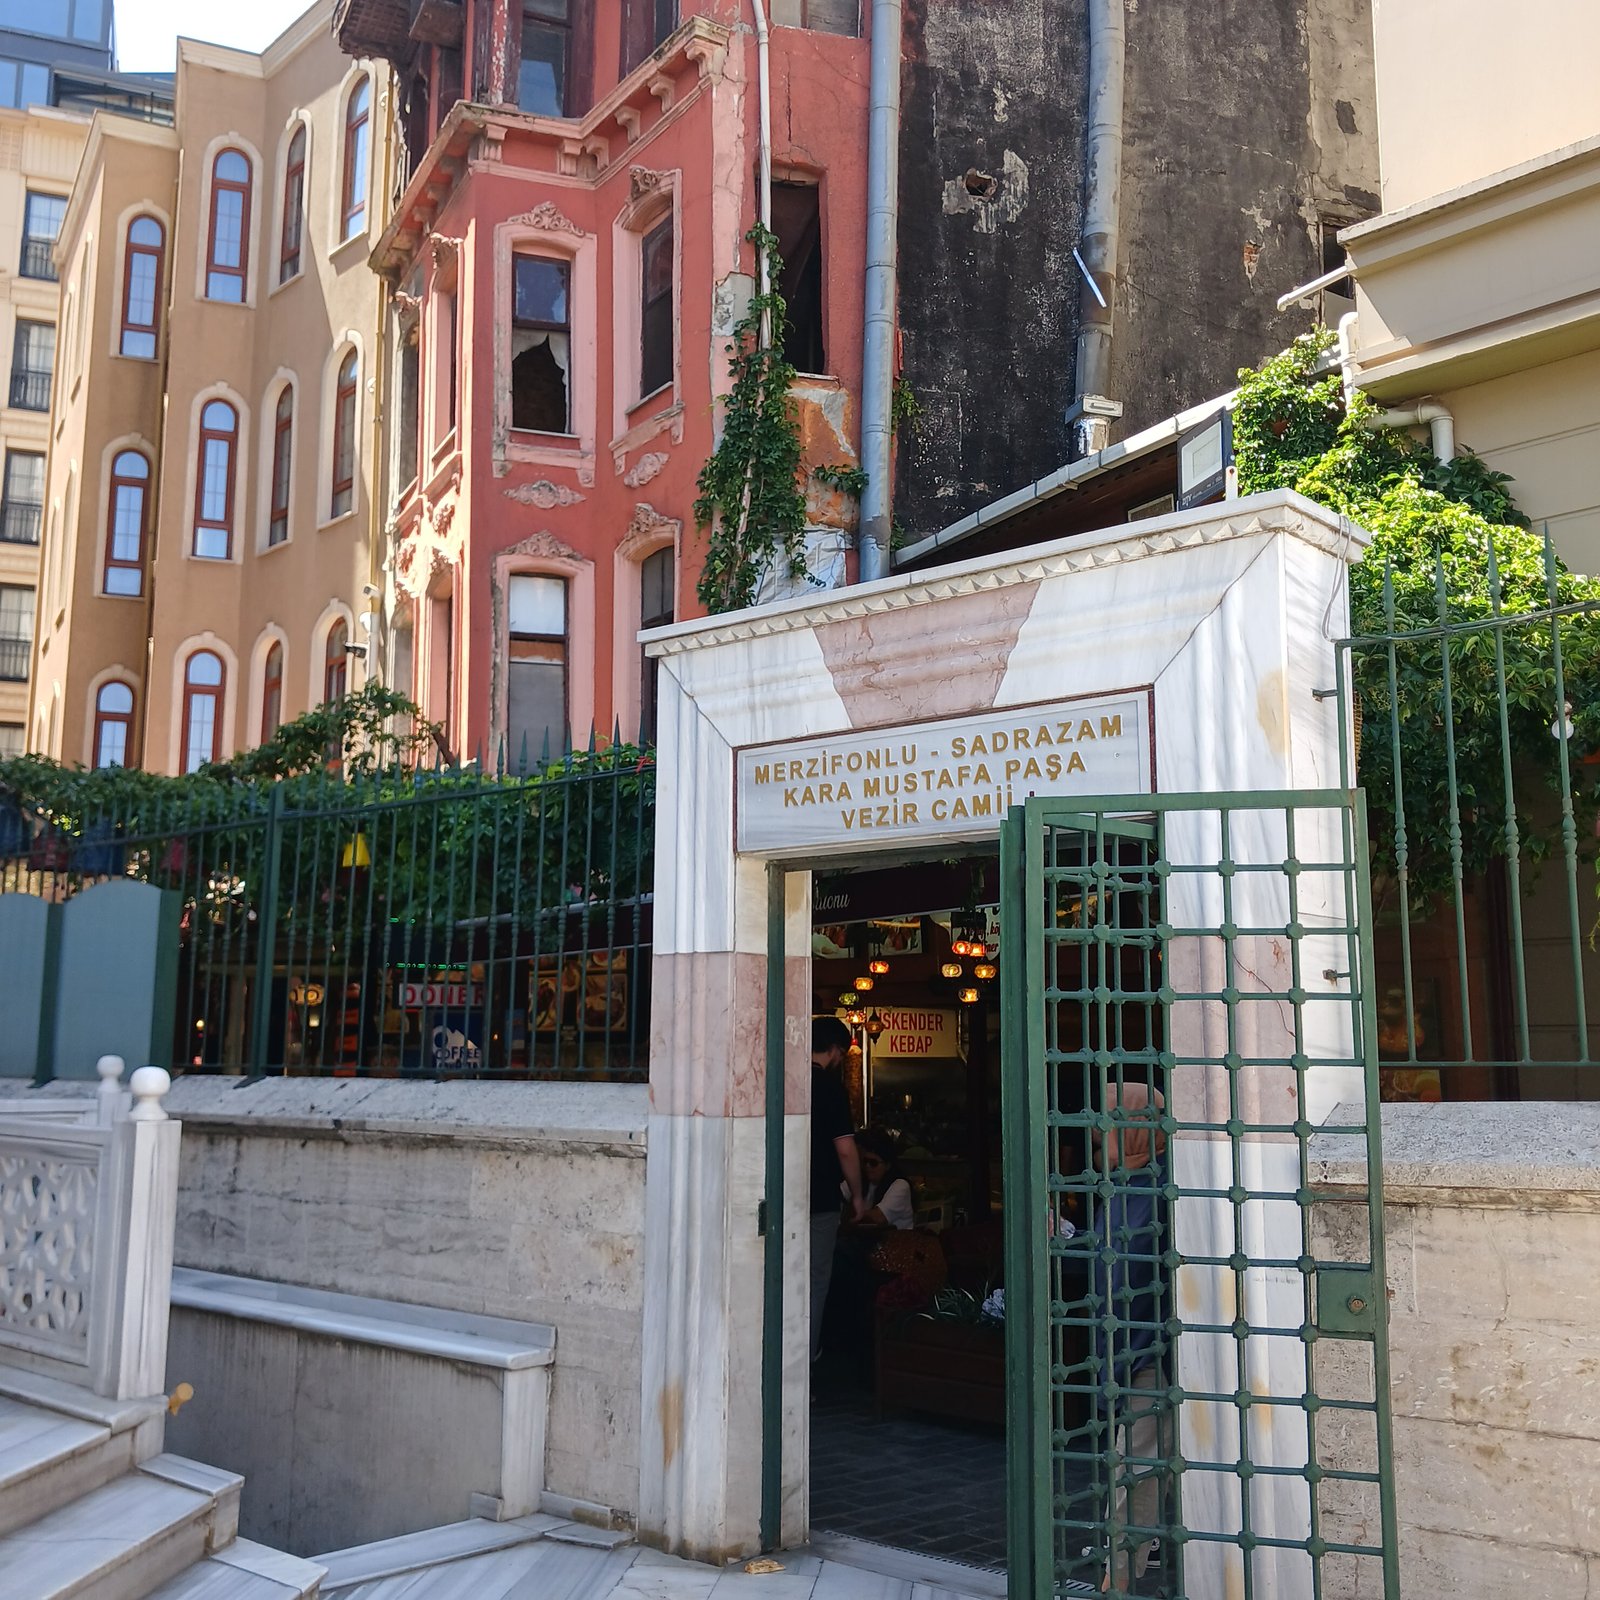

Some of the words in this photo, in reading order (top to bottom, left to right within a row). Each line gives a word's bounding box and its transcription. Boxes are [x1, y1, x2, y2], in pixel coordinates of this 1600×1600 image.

[754, 743, 918, 785] MERZİFONLU
[951, 714, 1124, 759] SADRAZAM
[783, 781, 852, 808] KARA
[863, 763, 992, 798] MUSTAFA
[1005, 750, 1087, 781] PAŞA
[841, 796, 919, 830] VEZİR
[889, 1034, 933, 1053] KEBAP
